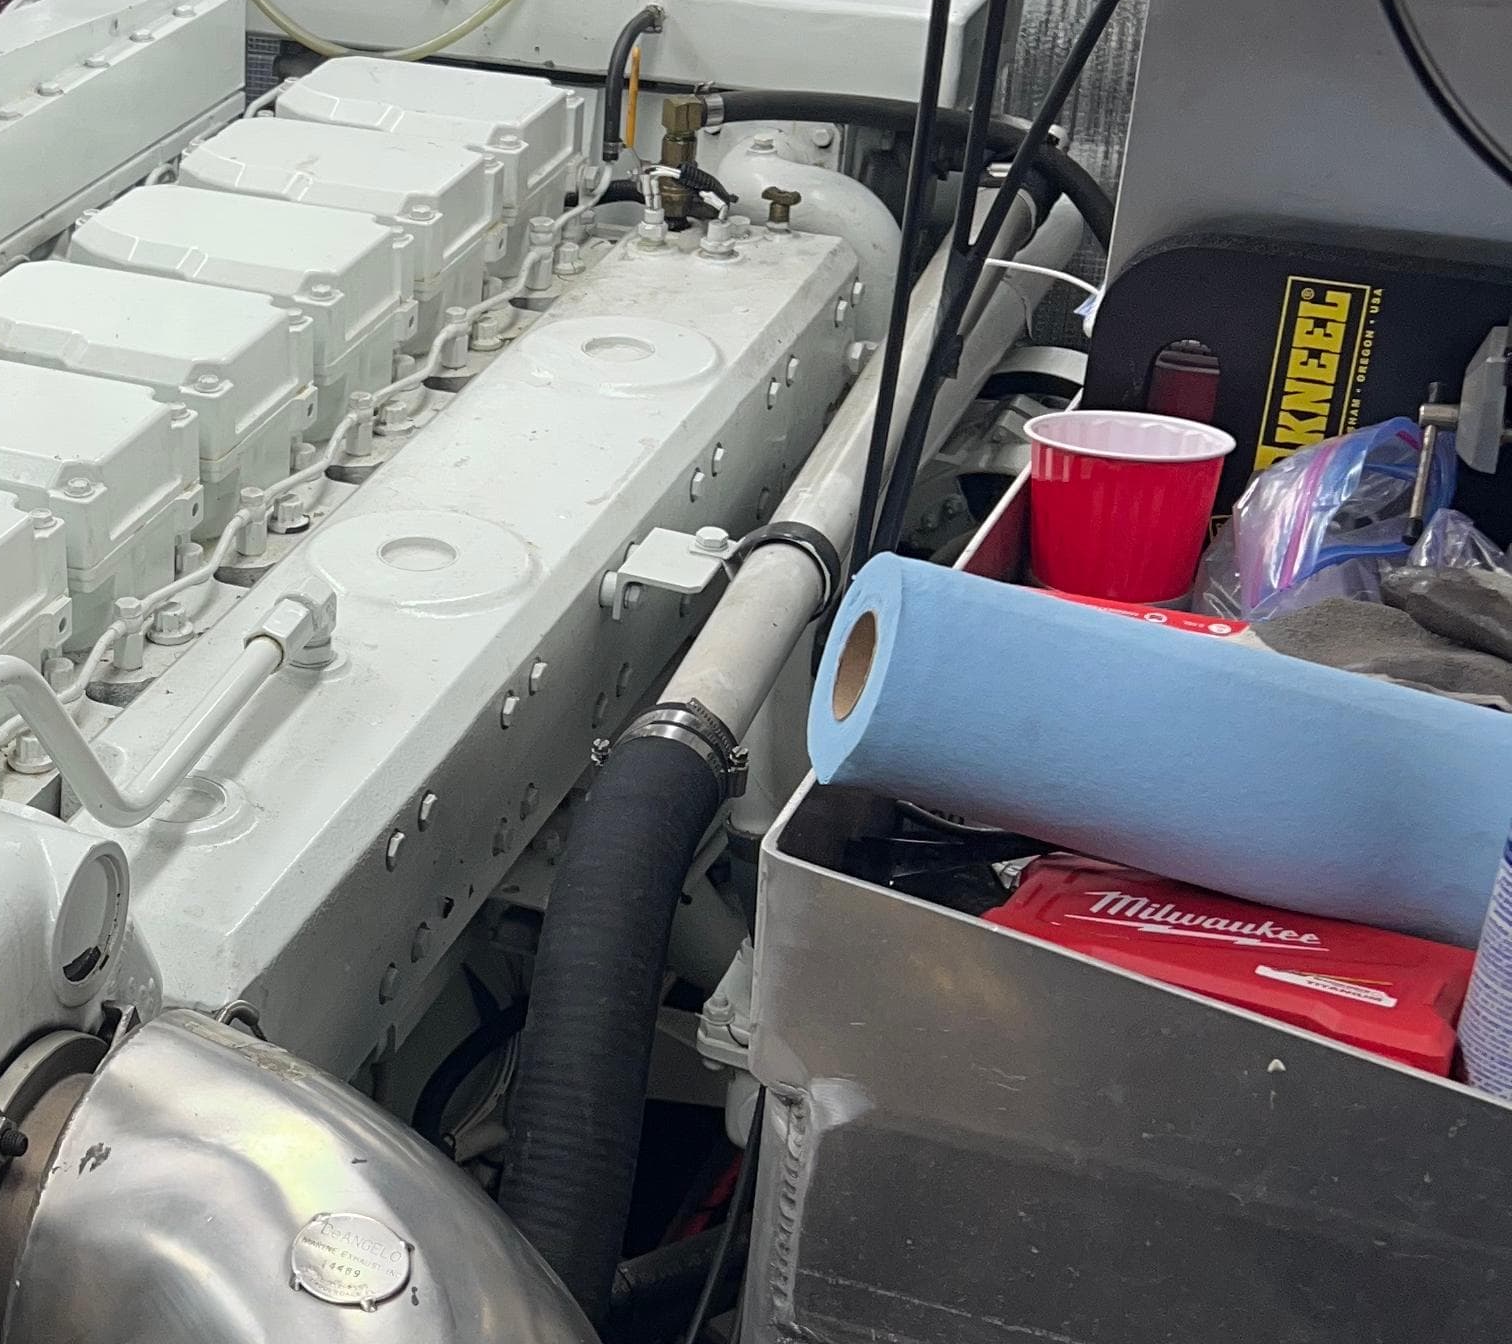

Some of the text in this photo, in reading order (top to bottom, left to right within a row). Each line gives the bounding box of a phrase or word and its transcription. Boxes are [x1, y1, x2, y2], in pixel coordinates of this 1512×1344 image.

[1256, 289, 1353, 468] KNEEL
[1356, 329, 1376, 383] OREGON
[1369, 287, 1385, 314] USA
[1084, 890, 1322, 946] Milwaukee
